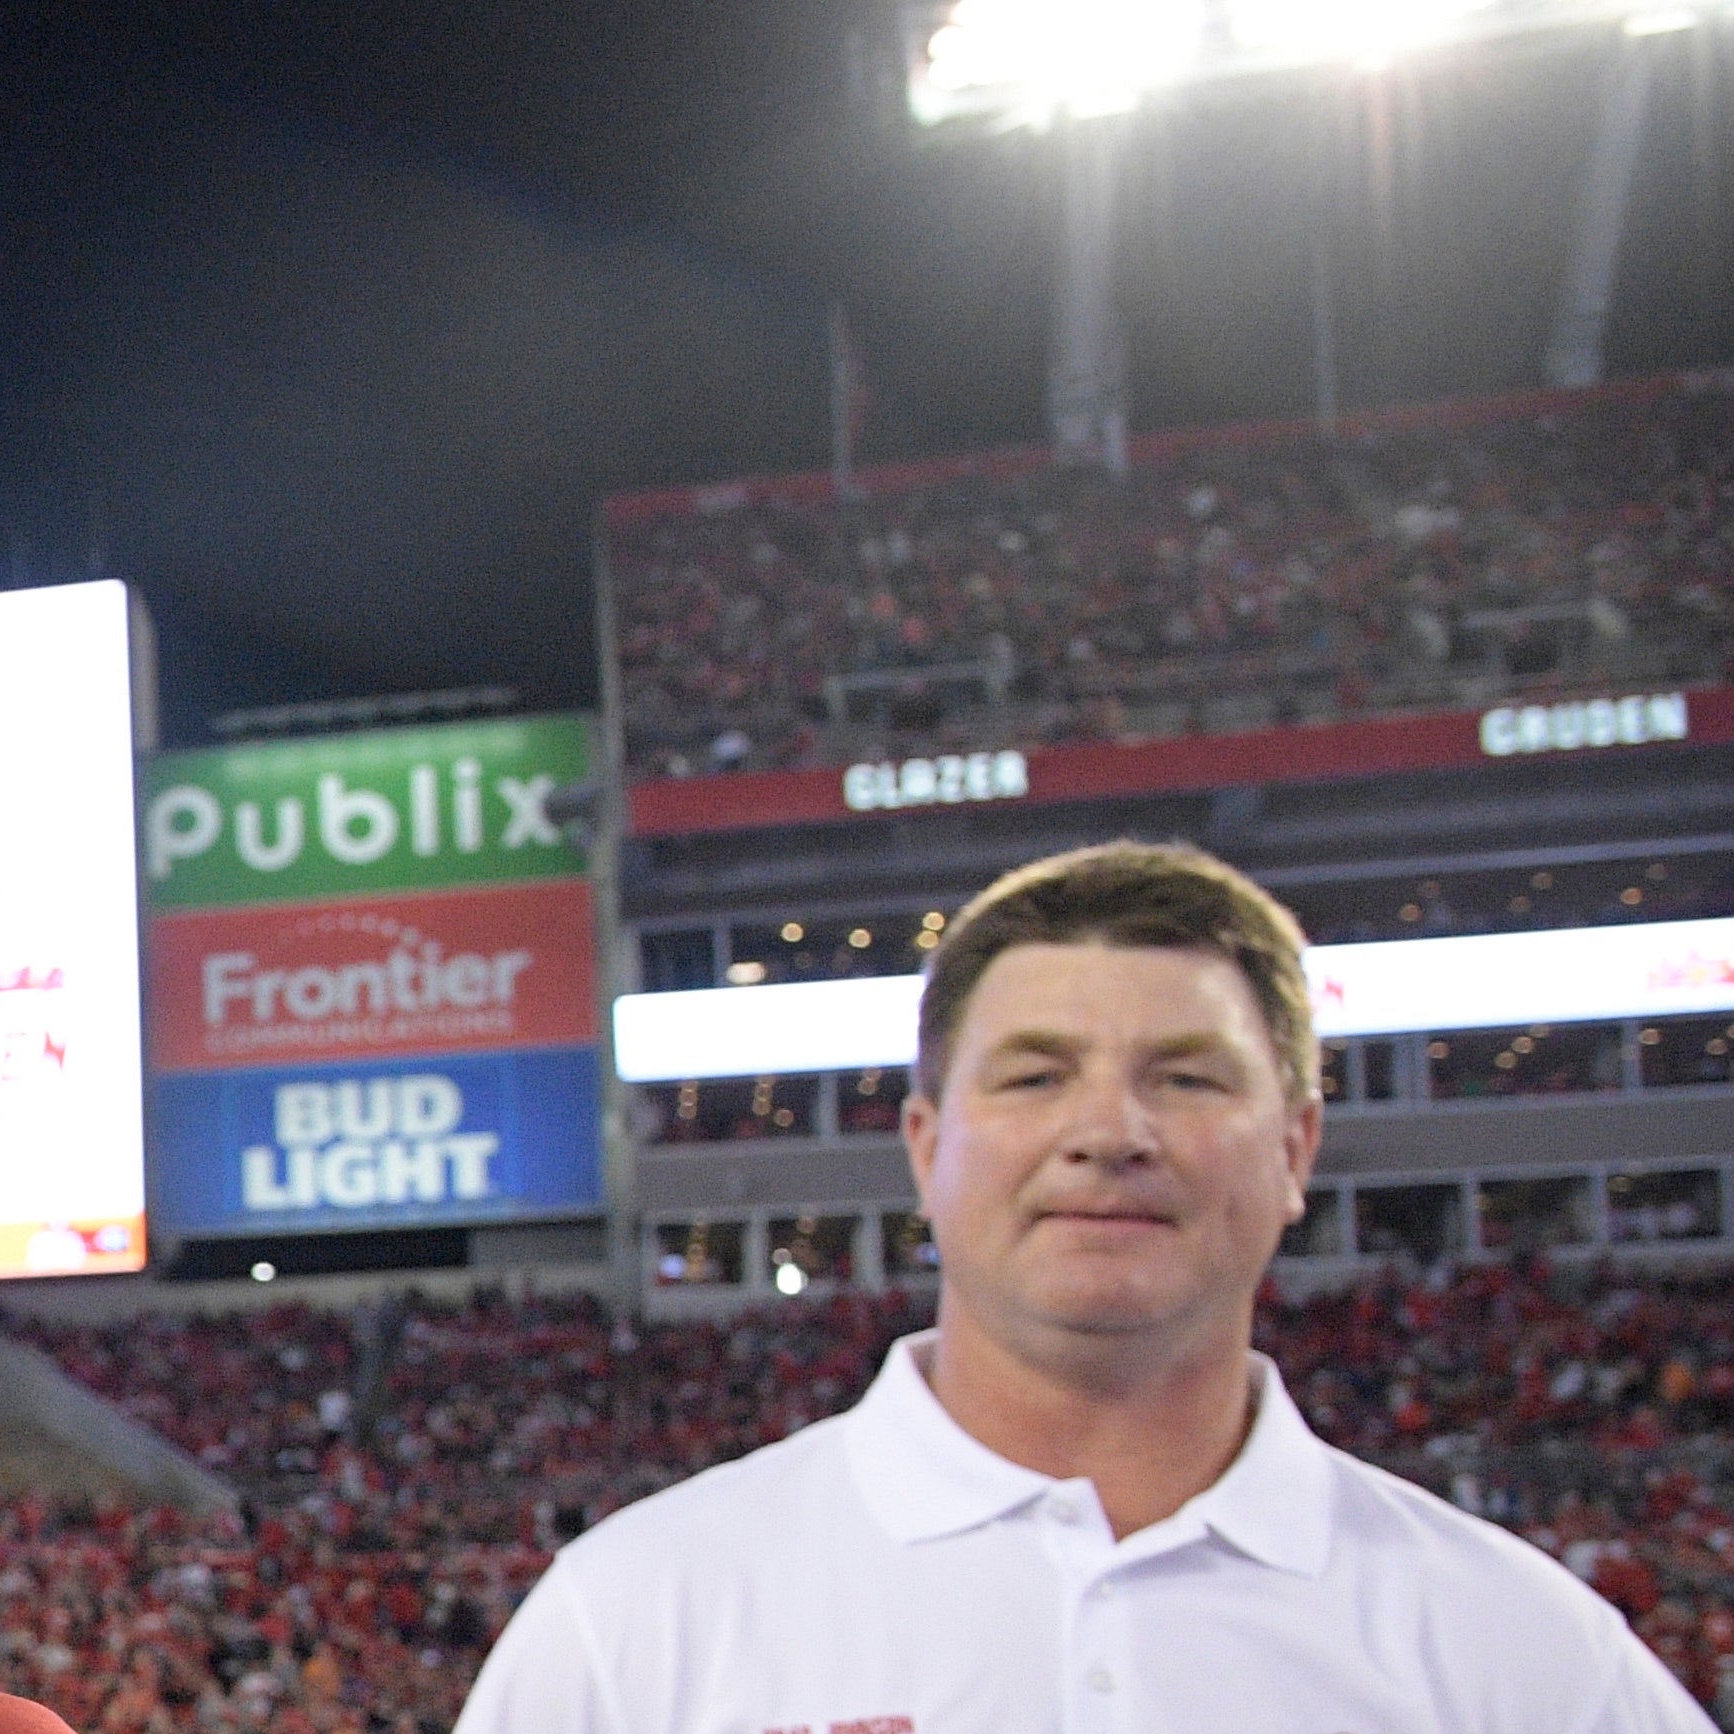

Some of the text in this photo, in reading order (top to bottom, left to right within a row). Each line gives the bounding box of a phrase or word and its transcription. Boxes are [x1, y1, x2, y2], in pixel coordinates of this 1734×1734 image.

[1480, 693, 1688, 756] GRUDEN
[843, 748, 1030, 811] GLAZER
[203, 938, 533, 1025] Frontier
[275, 1074, 464, 1147] BUD
[241, 1130, 499, 1210] LIGHT
